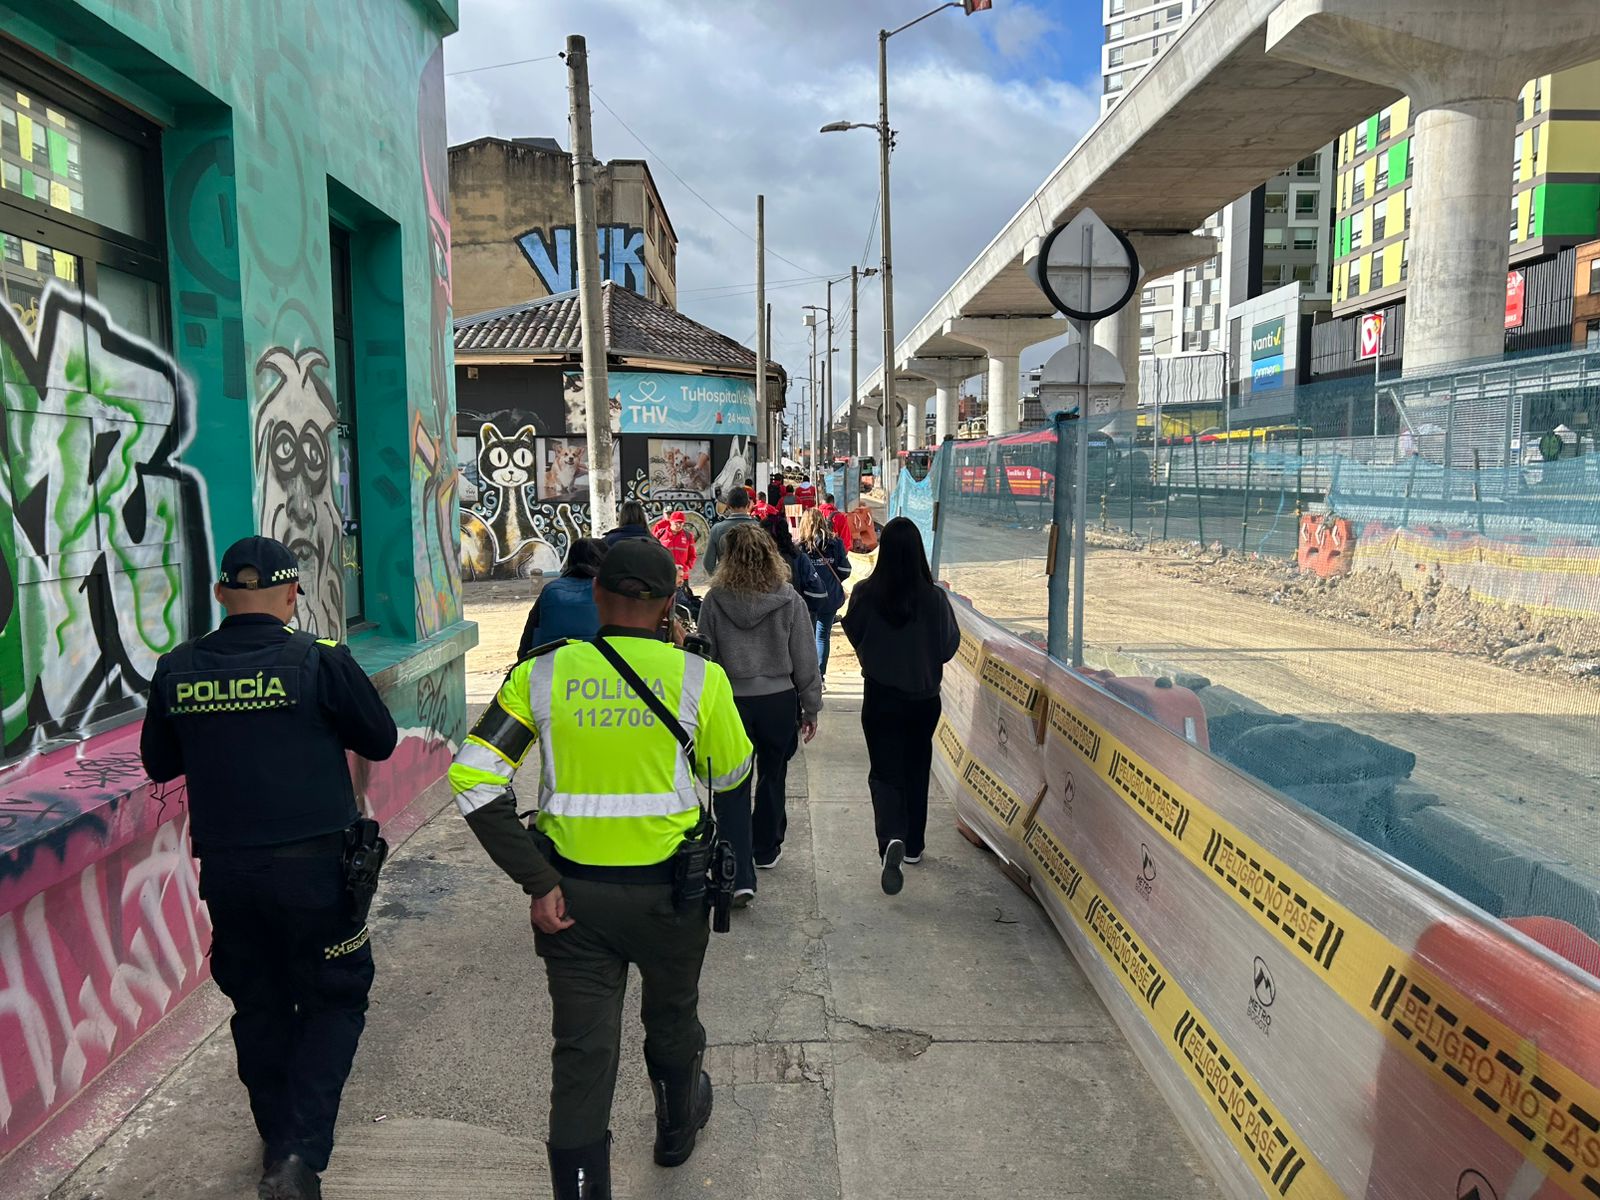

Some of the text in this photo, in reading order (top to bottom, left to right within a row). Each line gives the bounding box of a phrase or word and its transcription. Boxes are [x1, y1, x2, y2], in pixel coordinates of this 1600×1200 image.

[1252, 331, 1274, 351] vanti
[628, 405, 668, 425] THV
[727, 412, 736, 423] 24
[176, 671, 286, 703] POLICÍA
[566, 678, 665, 701] POLICA
[574, 708, 655, 727] 112706
[1119, 762, 1176, 821] PELIGRO NO PASE
[1220, 848, 1318, 940] PELIGRO NO PASE
[1095, 910, 1150, 988] PELIGRO NO PASE
[1249, 995, 1271, 1026] METRO
[1188, 1034, 1277, 1163] PELIGRO NO PASE
[1402, 997, 1600, 1169] PELIGRO NO PAS
